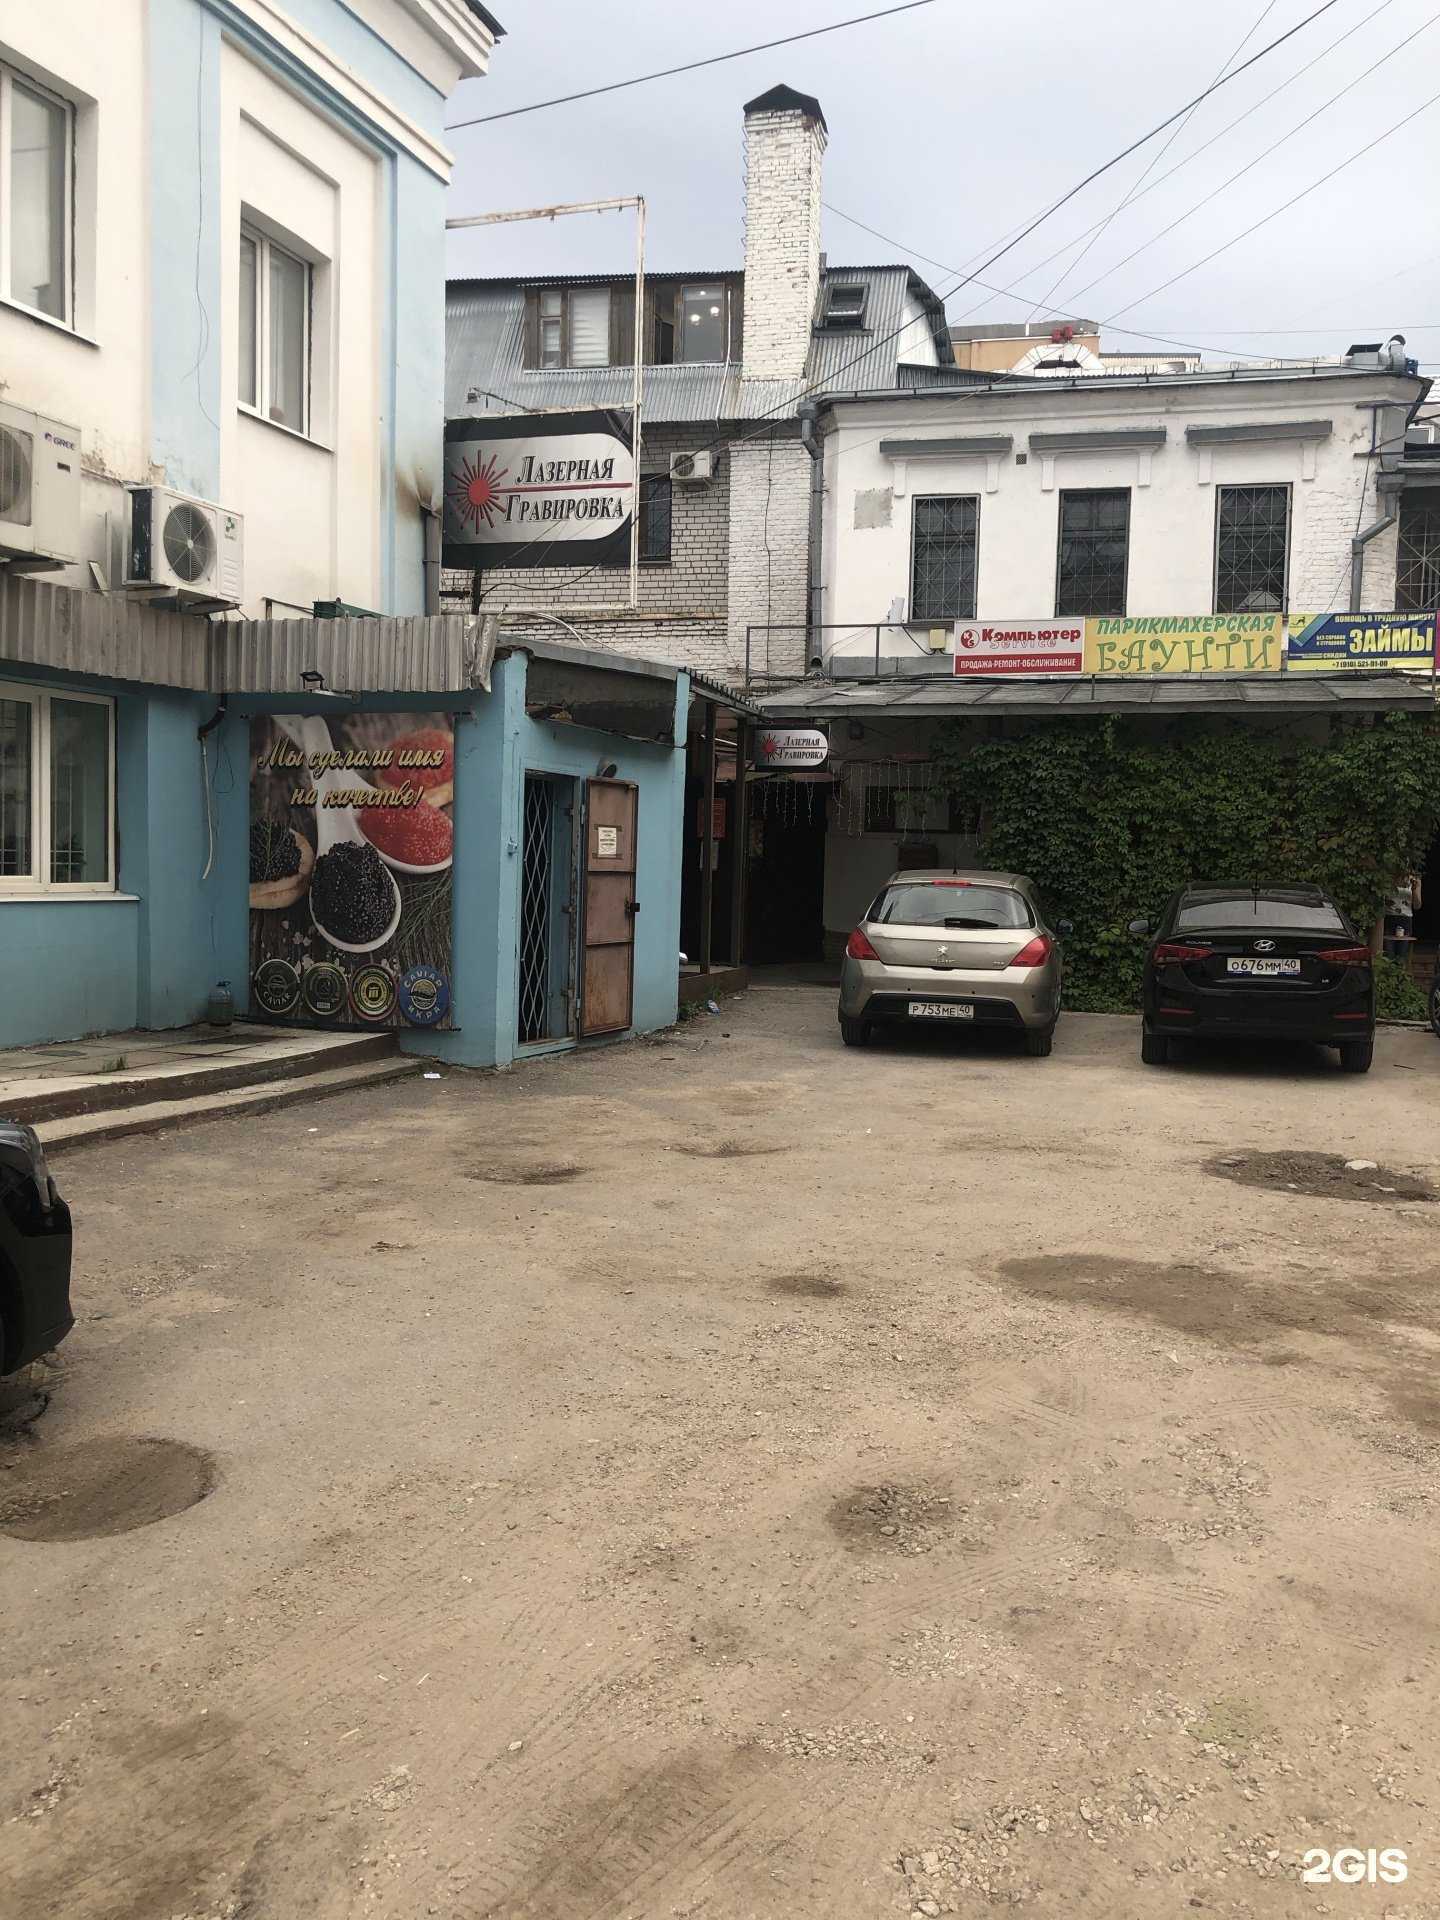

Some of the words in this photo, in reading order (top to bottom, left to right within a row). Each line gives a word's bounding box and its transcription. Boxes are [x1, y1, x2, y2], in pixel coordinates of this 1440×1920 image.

[982, 629, 1081, 643] Компьютер
[1097, 615, 1276, 634] ПАРИКМАХЕРСКАЯ
[1349, 624, 1434, 654] ЗАЙМЫ
[1097, 633, 1275, 673] БАУНТИ
[257, 736, 304, 769] Мы
[308, 749, 393, 779] сделали
[398, 748, 446, 768] имя
[290, 787, 319, 806] на
[321, 779, 424, 808] качестве!
